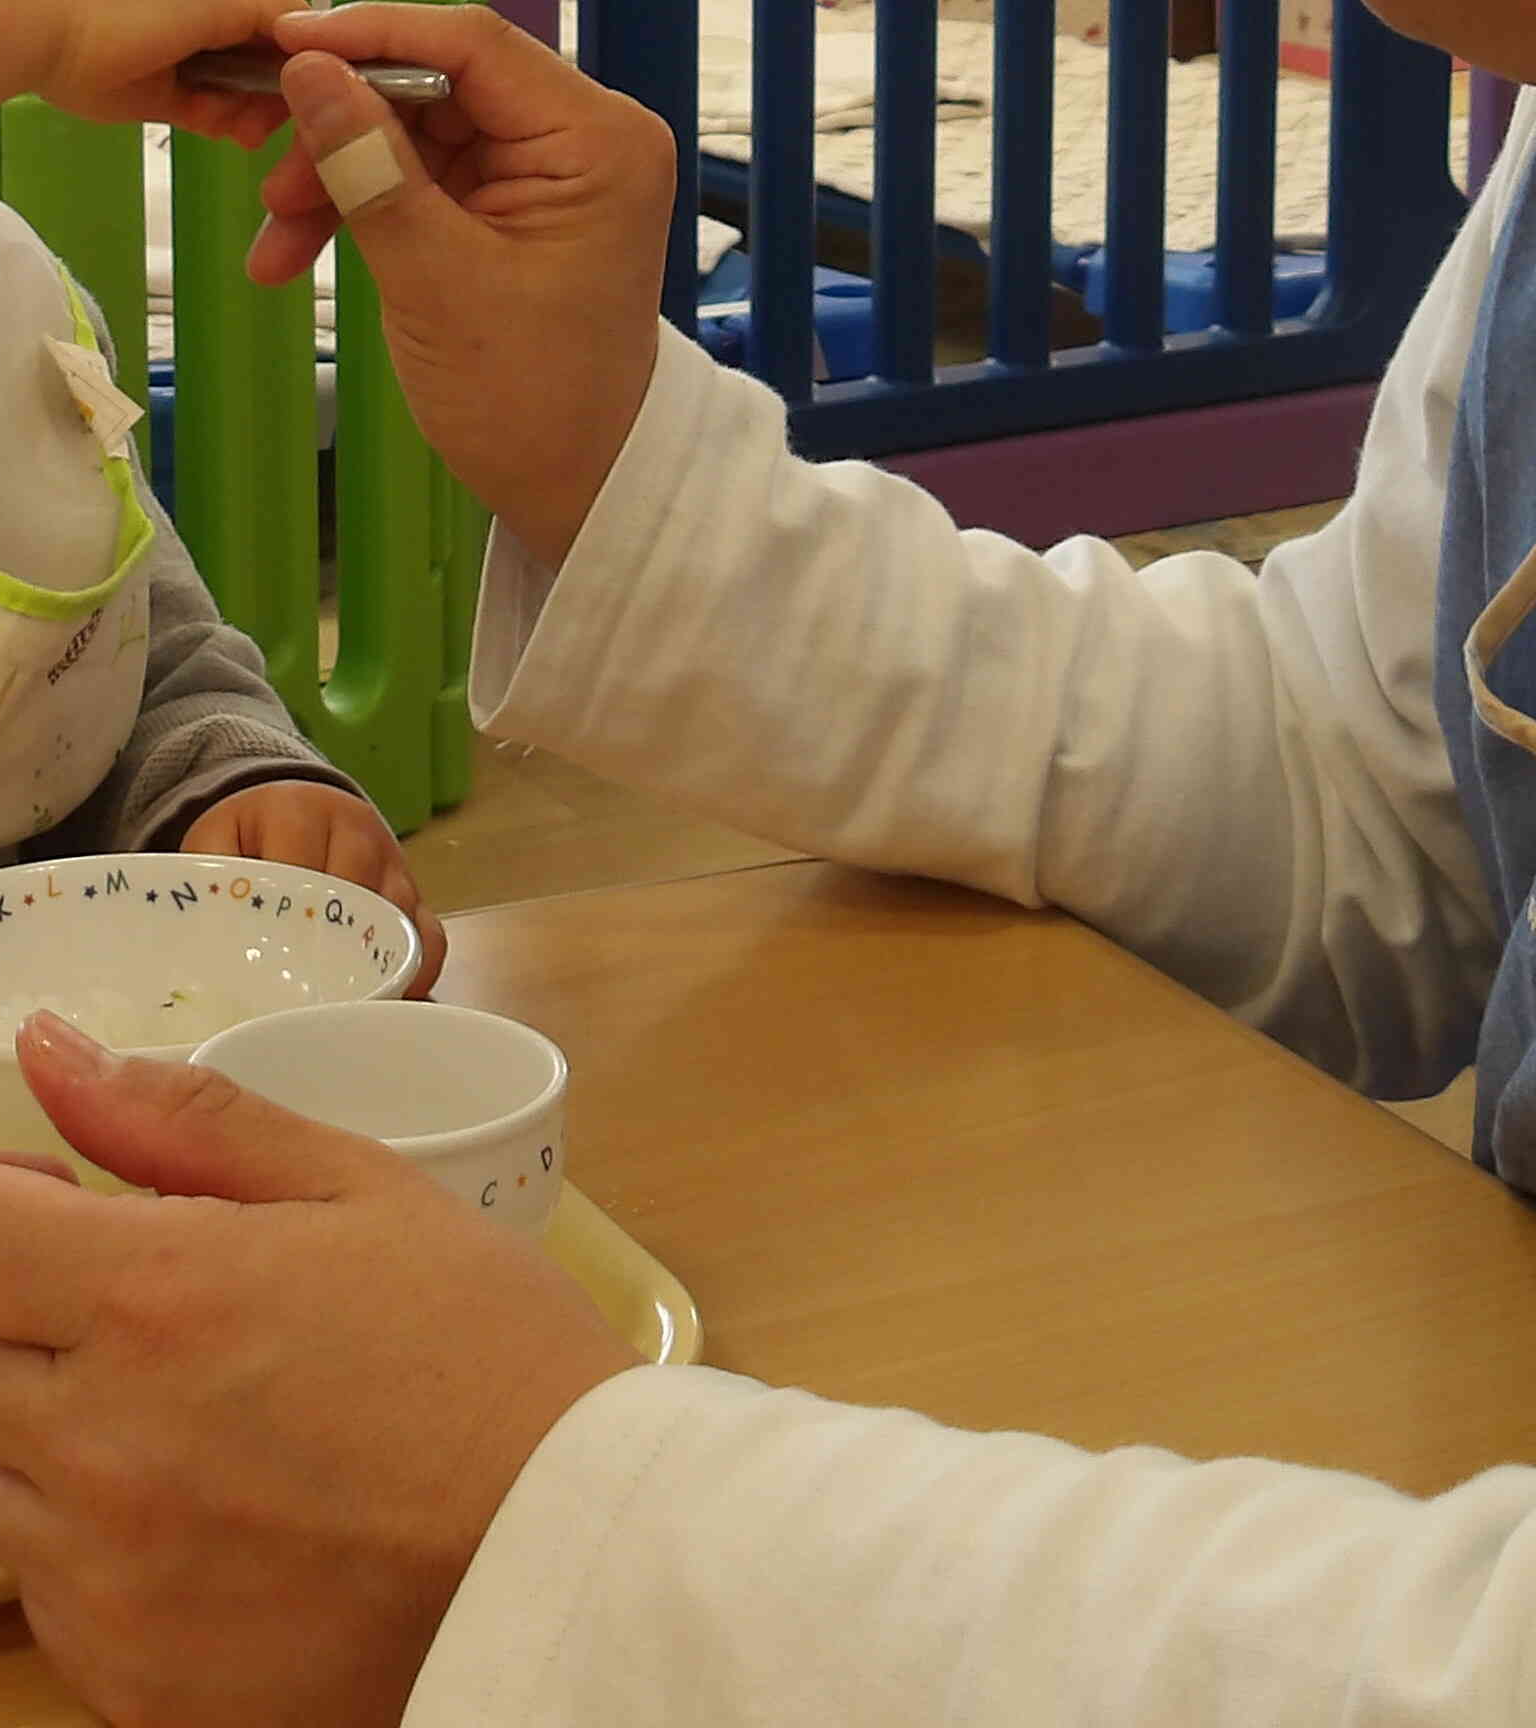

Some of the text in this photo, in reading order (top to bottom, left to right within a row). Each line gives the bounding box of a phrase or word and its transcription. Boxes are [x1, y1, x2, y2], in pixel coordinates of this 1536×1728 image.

[47, 874, 63, 897] L
[106, 869, 130, 896] M
[170, 881, 198, 911] N
[229, 877, 251, 900] O
[325, 898, 344, 925] Q
[481, 1146, 553, 1206] C D
